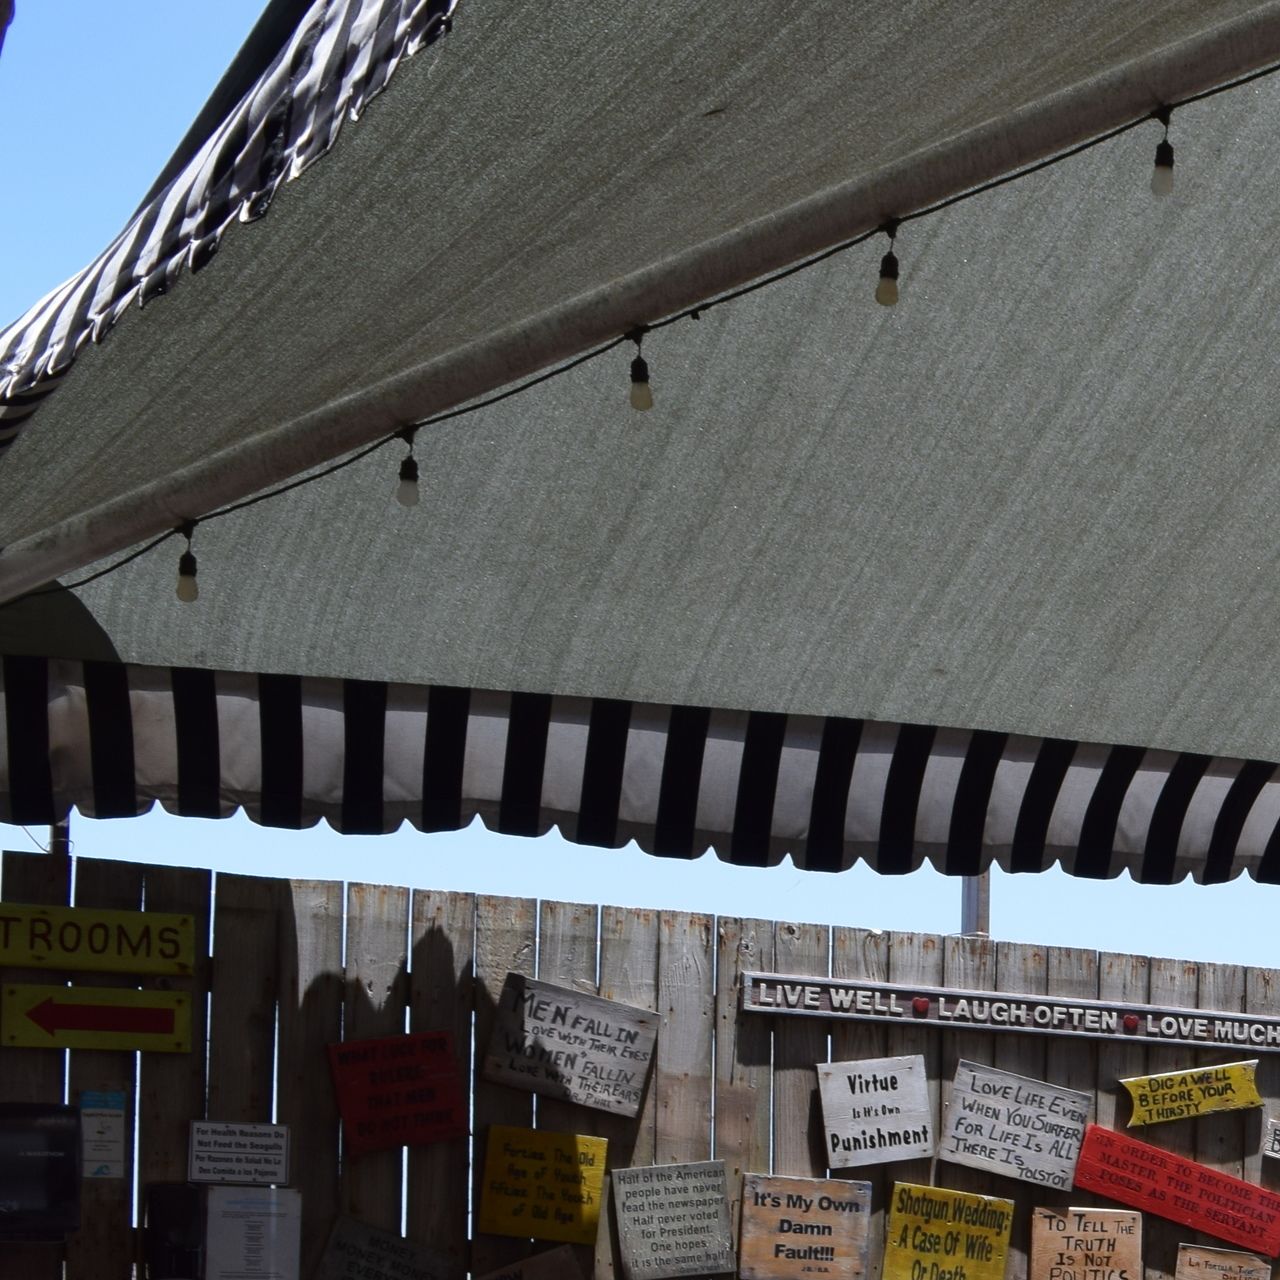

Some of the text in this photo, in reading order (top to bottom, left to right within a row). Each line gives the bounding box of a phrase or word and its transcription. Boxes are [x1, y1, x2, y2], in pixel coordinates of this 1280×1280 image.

[759, 982, 821, 1006] LIVE
[830, 988, 904, 1013] WELL
[939, 997, 1026, 1023] LAUGH
[1034, 1005, 1117, 1031] OFTEN
[1146, 1015, 1208, 1038] LOVE
[847, 1074, 898, 1094] Virtue
[1148, 1069, 1232, 1092] DIG A WELL
[1139, 1083, 1235, 1107] BEFORE YOUR
[853, 1108, 860, 1119] Is
[882, 1105, 900, 1115] Own
[1146, 1102, 1200, 1121] THIRSTY
[831, 1125, 928, 1153] Punishment
[754, 1192, 861, 1213] It's My Own
[896, 1188, 948, 1224] Shotgun
[779, 1219, 832, 1236] Damn
[1044, 1214, 1135, 1234] TO TELL THE
[774, 1244, 834, 1261] Fault!!!
[898, 1224, 992, 1262] A Case Of Wife
[1062, 1236, 1116, 1252] TRUTH
[1085, 1253, 1112, 1266] NOT
